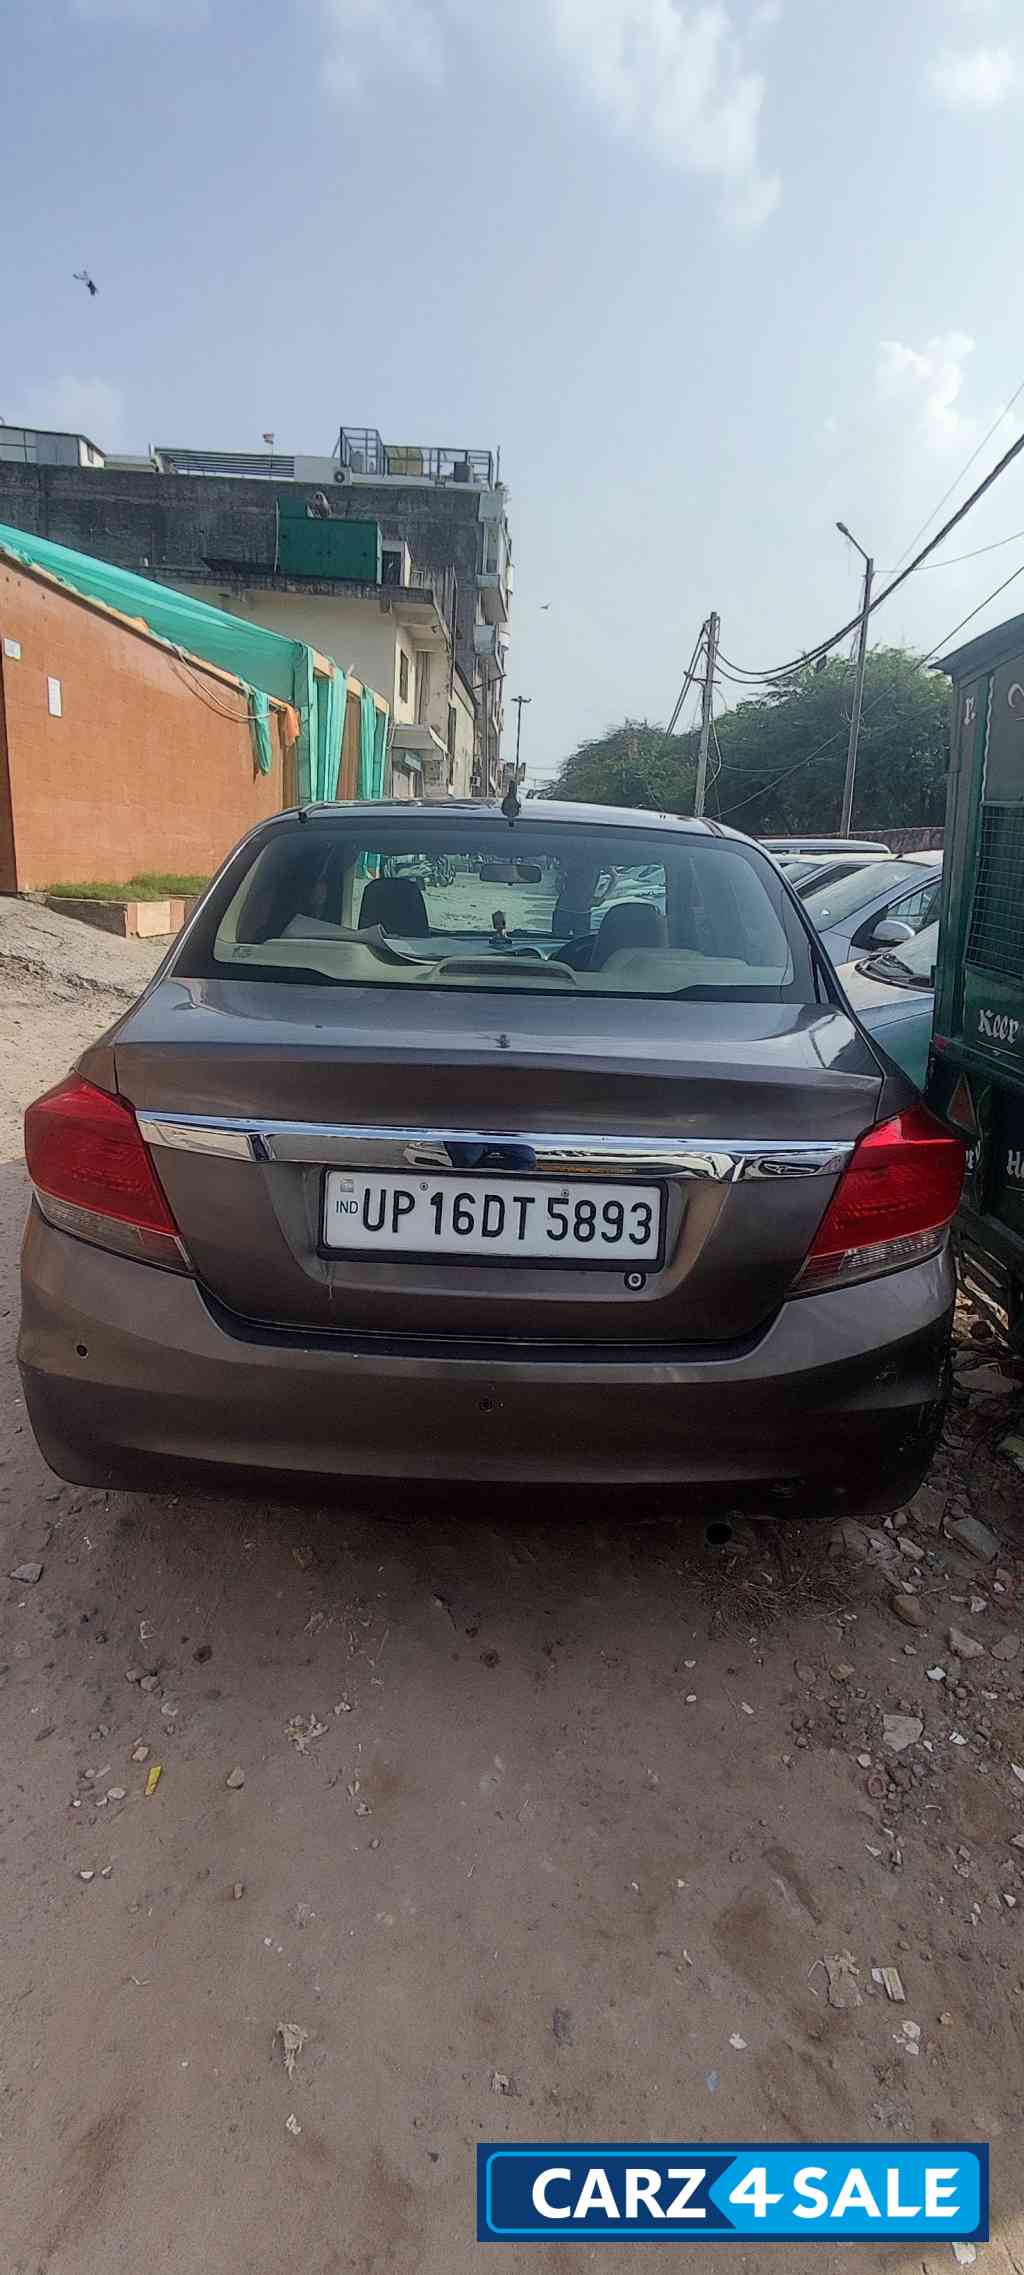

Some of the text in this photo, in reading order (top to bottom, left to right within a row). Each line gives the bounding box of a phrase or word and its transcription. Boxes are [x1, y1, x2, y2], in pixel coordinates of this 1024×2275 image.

[336, 1200, 359, 1214] IND
[363, 1188, 652, 1245] UP 16DT 5893
